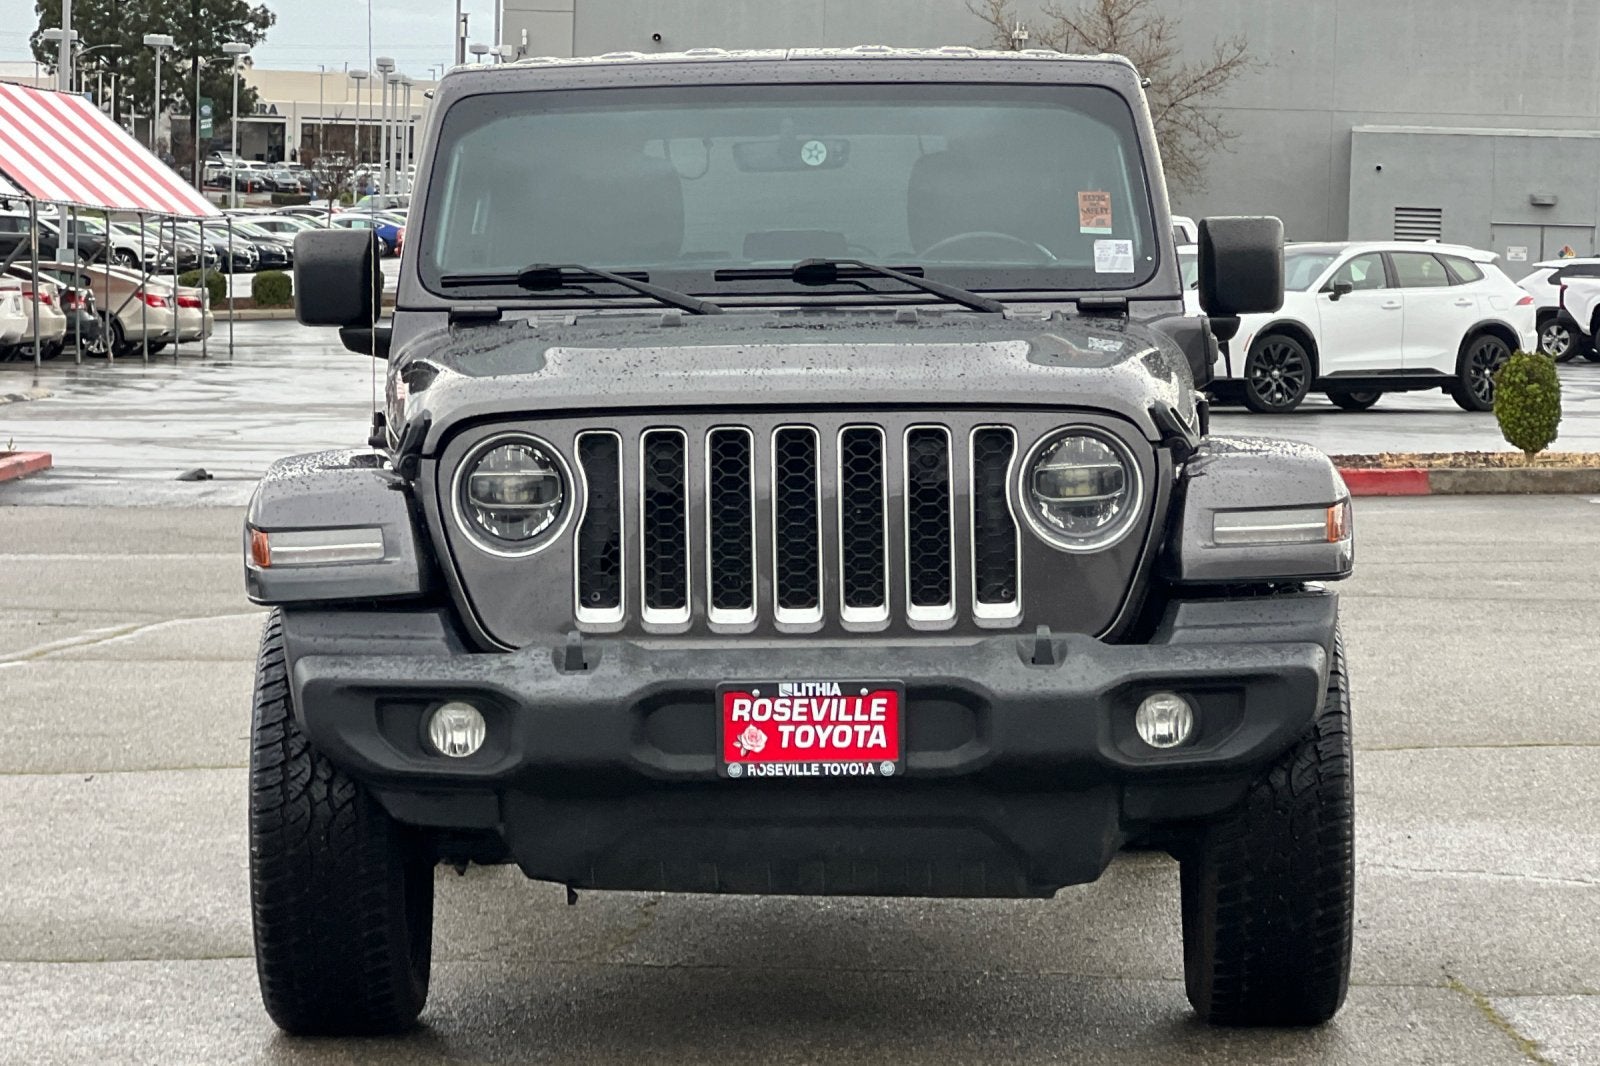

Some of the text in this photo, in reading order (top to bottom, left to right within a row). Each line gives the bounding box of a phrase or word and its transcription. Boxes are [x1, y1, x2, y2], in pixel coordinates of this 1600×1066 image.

[793, 682, 841, 697] LITHIA
[732, 698, 888, 722] ROSEVILLE
[778, 725, 887, 748] TOYOTA
[747, 764, 820, 776] ROSEVILLE
[824, 763, 875, 775] TOYOTA
